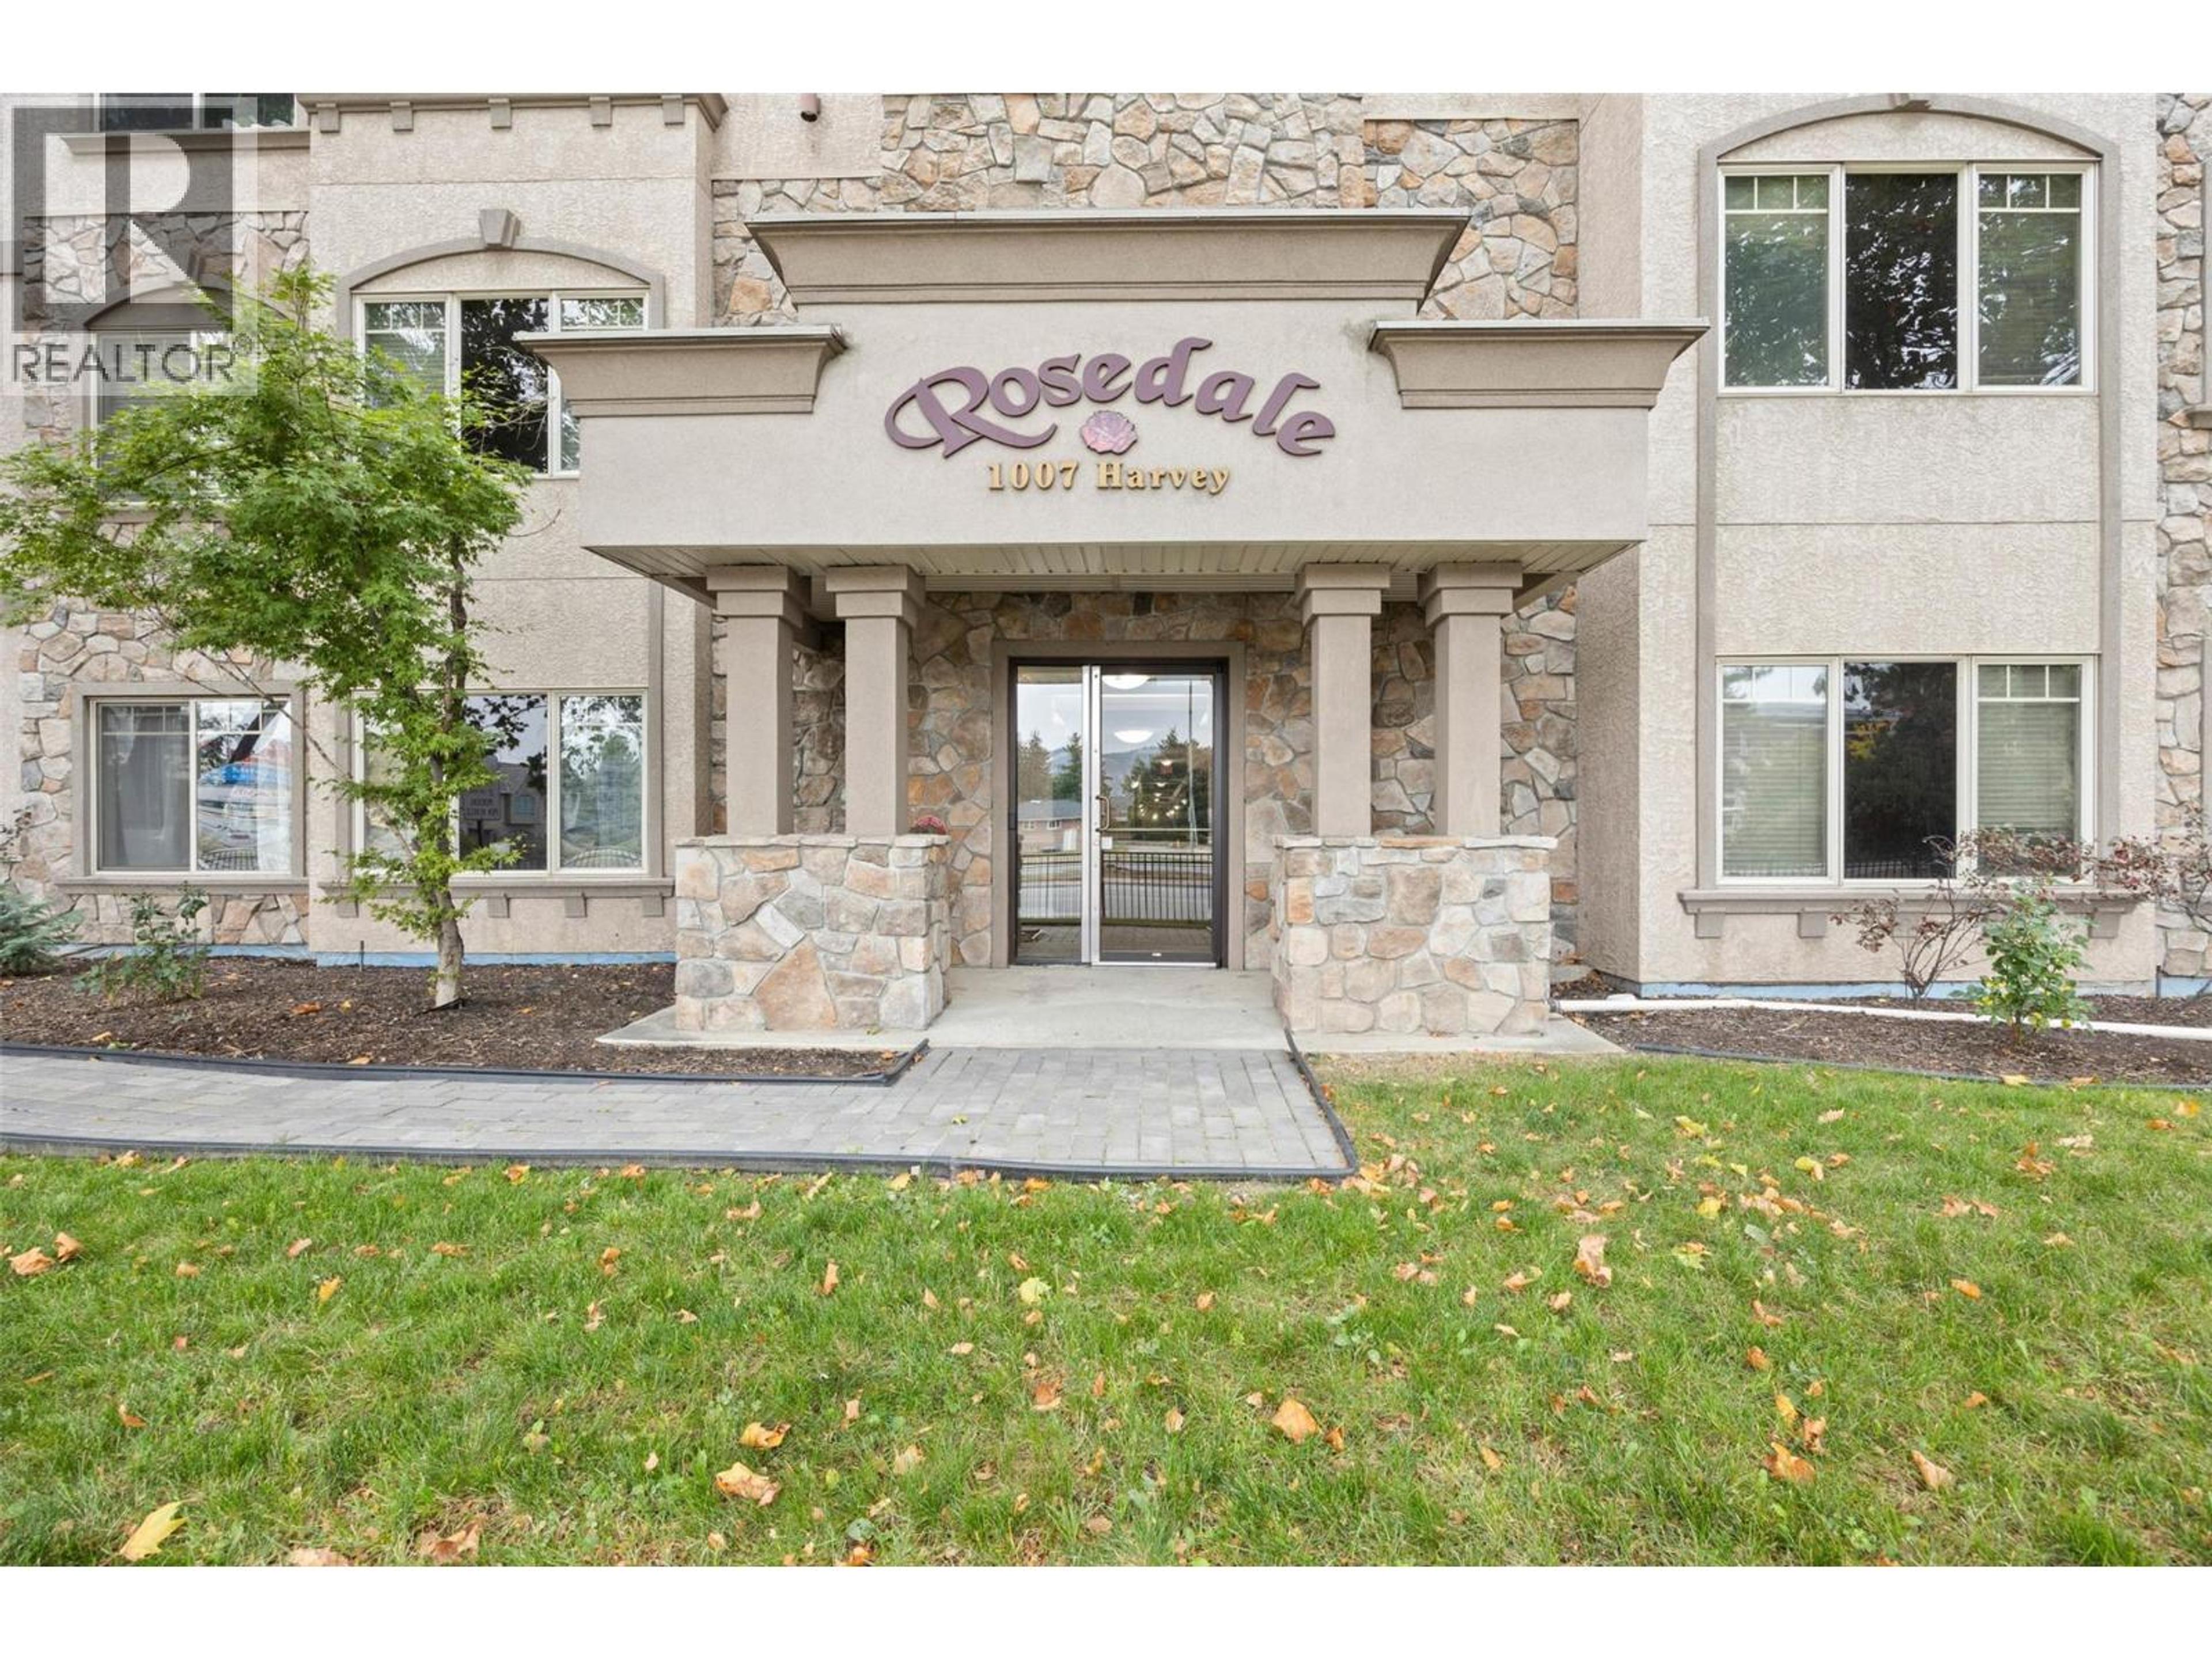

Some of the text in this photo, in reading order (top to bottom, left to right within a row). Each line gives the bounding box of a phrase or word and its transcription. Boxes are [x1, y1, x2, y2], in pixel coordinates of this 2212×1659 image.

[885, 336, 1336, 459] Rosedale
[988, 461, 1230, 495] 1007 Harvey
